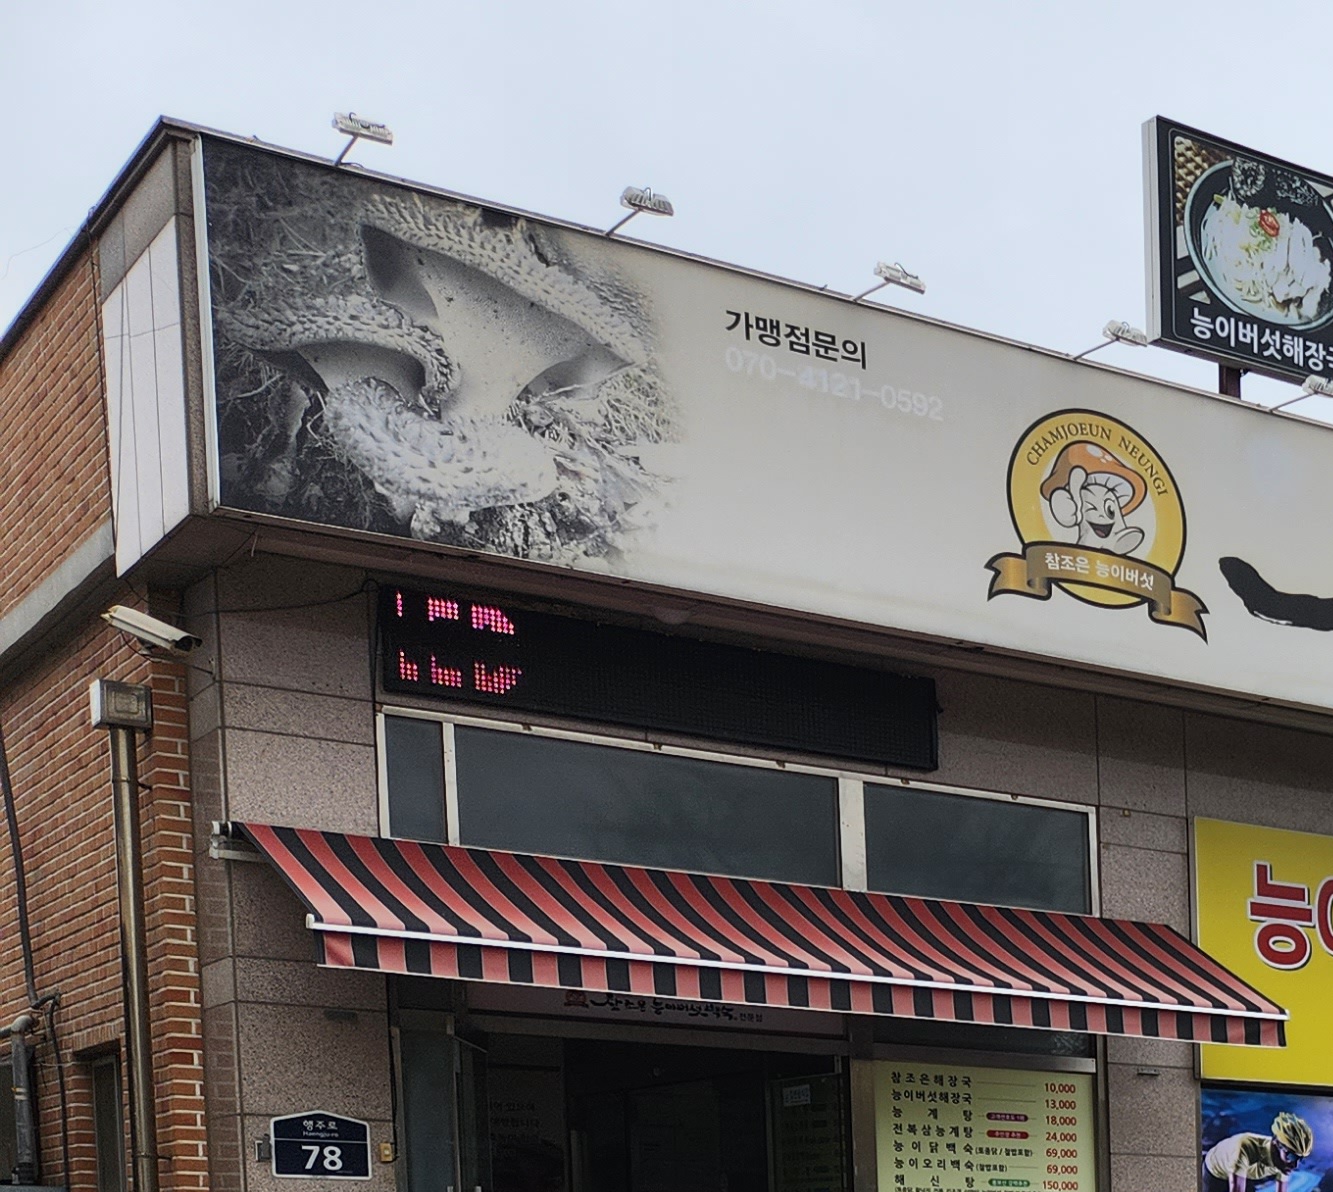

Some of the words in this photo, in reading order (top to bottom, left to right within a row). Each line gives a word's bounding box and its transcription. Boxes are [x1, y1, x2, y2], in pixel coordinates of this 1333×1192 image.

[725, 310, 867, 370] 가맹점문의
[1026, 423, 1112, 465] CHAMJOEUN
[1118, 436, 1167, 495] NEUNGI
[1045, 553, 1090, 574] 참조은
[1095, 563, 1154, 591] 능이버섯
[1044, 1083, 1076, 1094] 10,000
[891, 1089, 972, 1104] 능이버섯해장국
[1045, 1099, 1077, 1111] 13,000
[303, 1120, 338, 1131] 행주로
[1045, 1116, 1077, 1127] 18,000
[1046, 1132, 1077, 1143] 24,000
[302, 1145, 343, 1171] 78
[1046, 1148, 1078, 1160] 69,000
[1047, 1164, 1078, 1176] 69,000
[1043, 1181, 1079, 1192] 150,000
